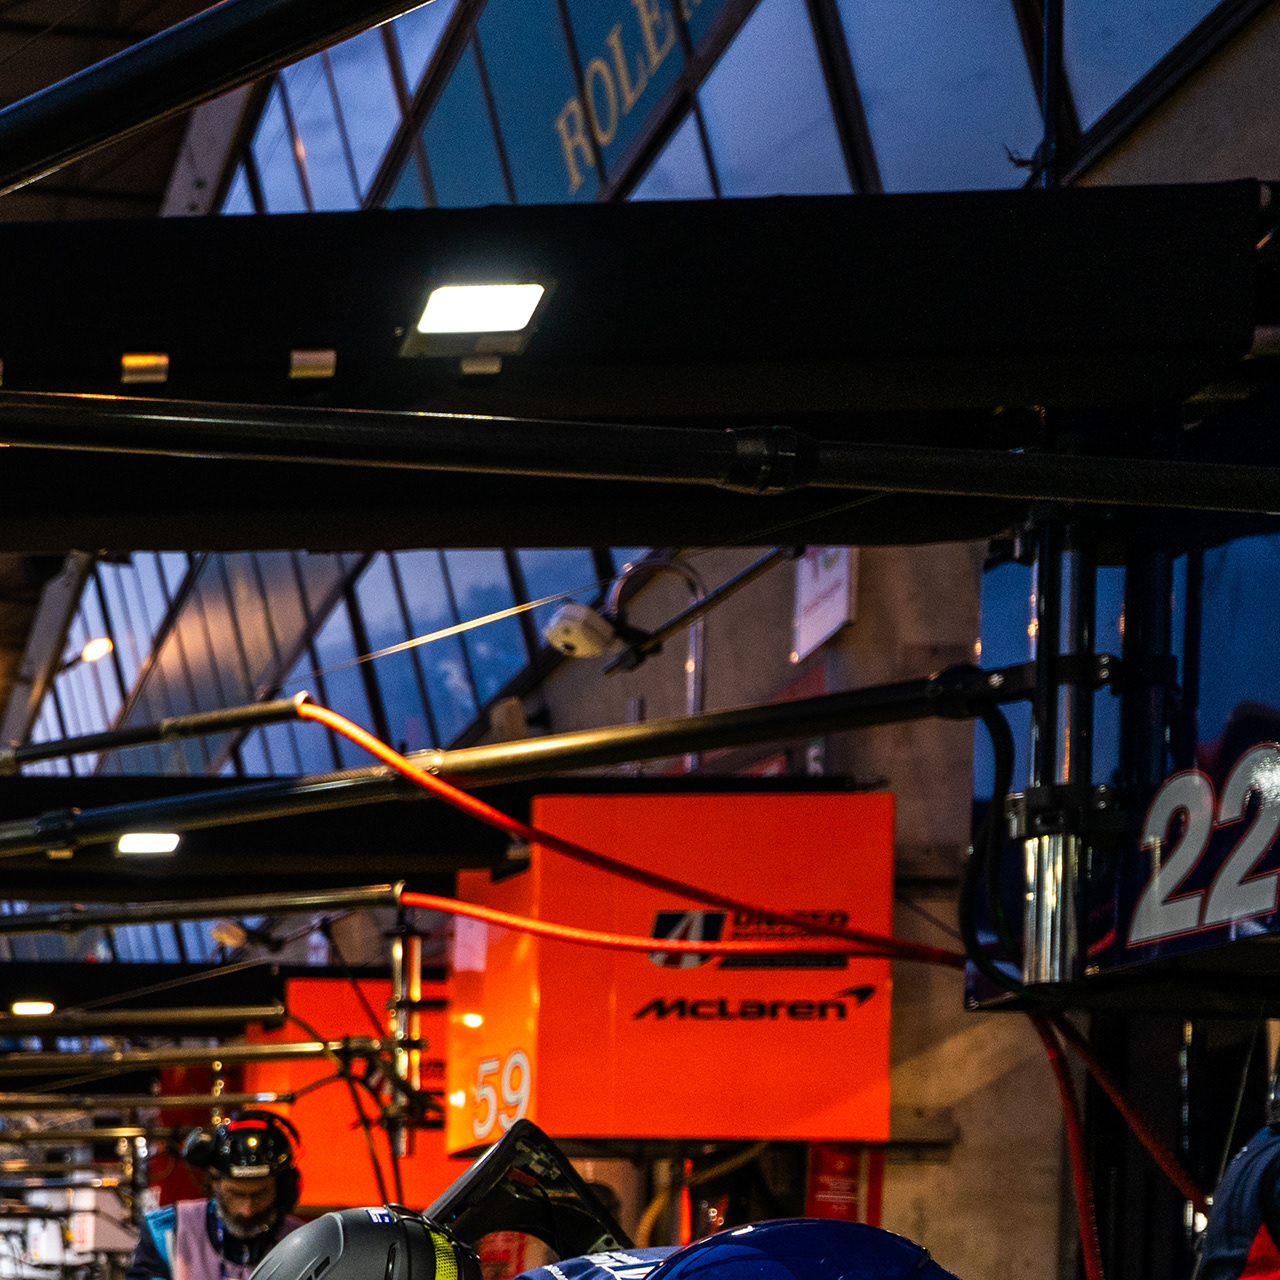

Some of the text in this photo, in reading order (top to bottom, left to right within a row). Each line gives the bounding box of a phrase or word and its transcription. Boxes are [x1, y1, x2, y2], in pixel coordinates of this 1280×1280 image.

[555, 0, 702, 195] ROLE
[1127, 742, 1280, 949] 22
[633, 996, 849, 1021] McLaren
[474, 1050, 531, 1139] 59
